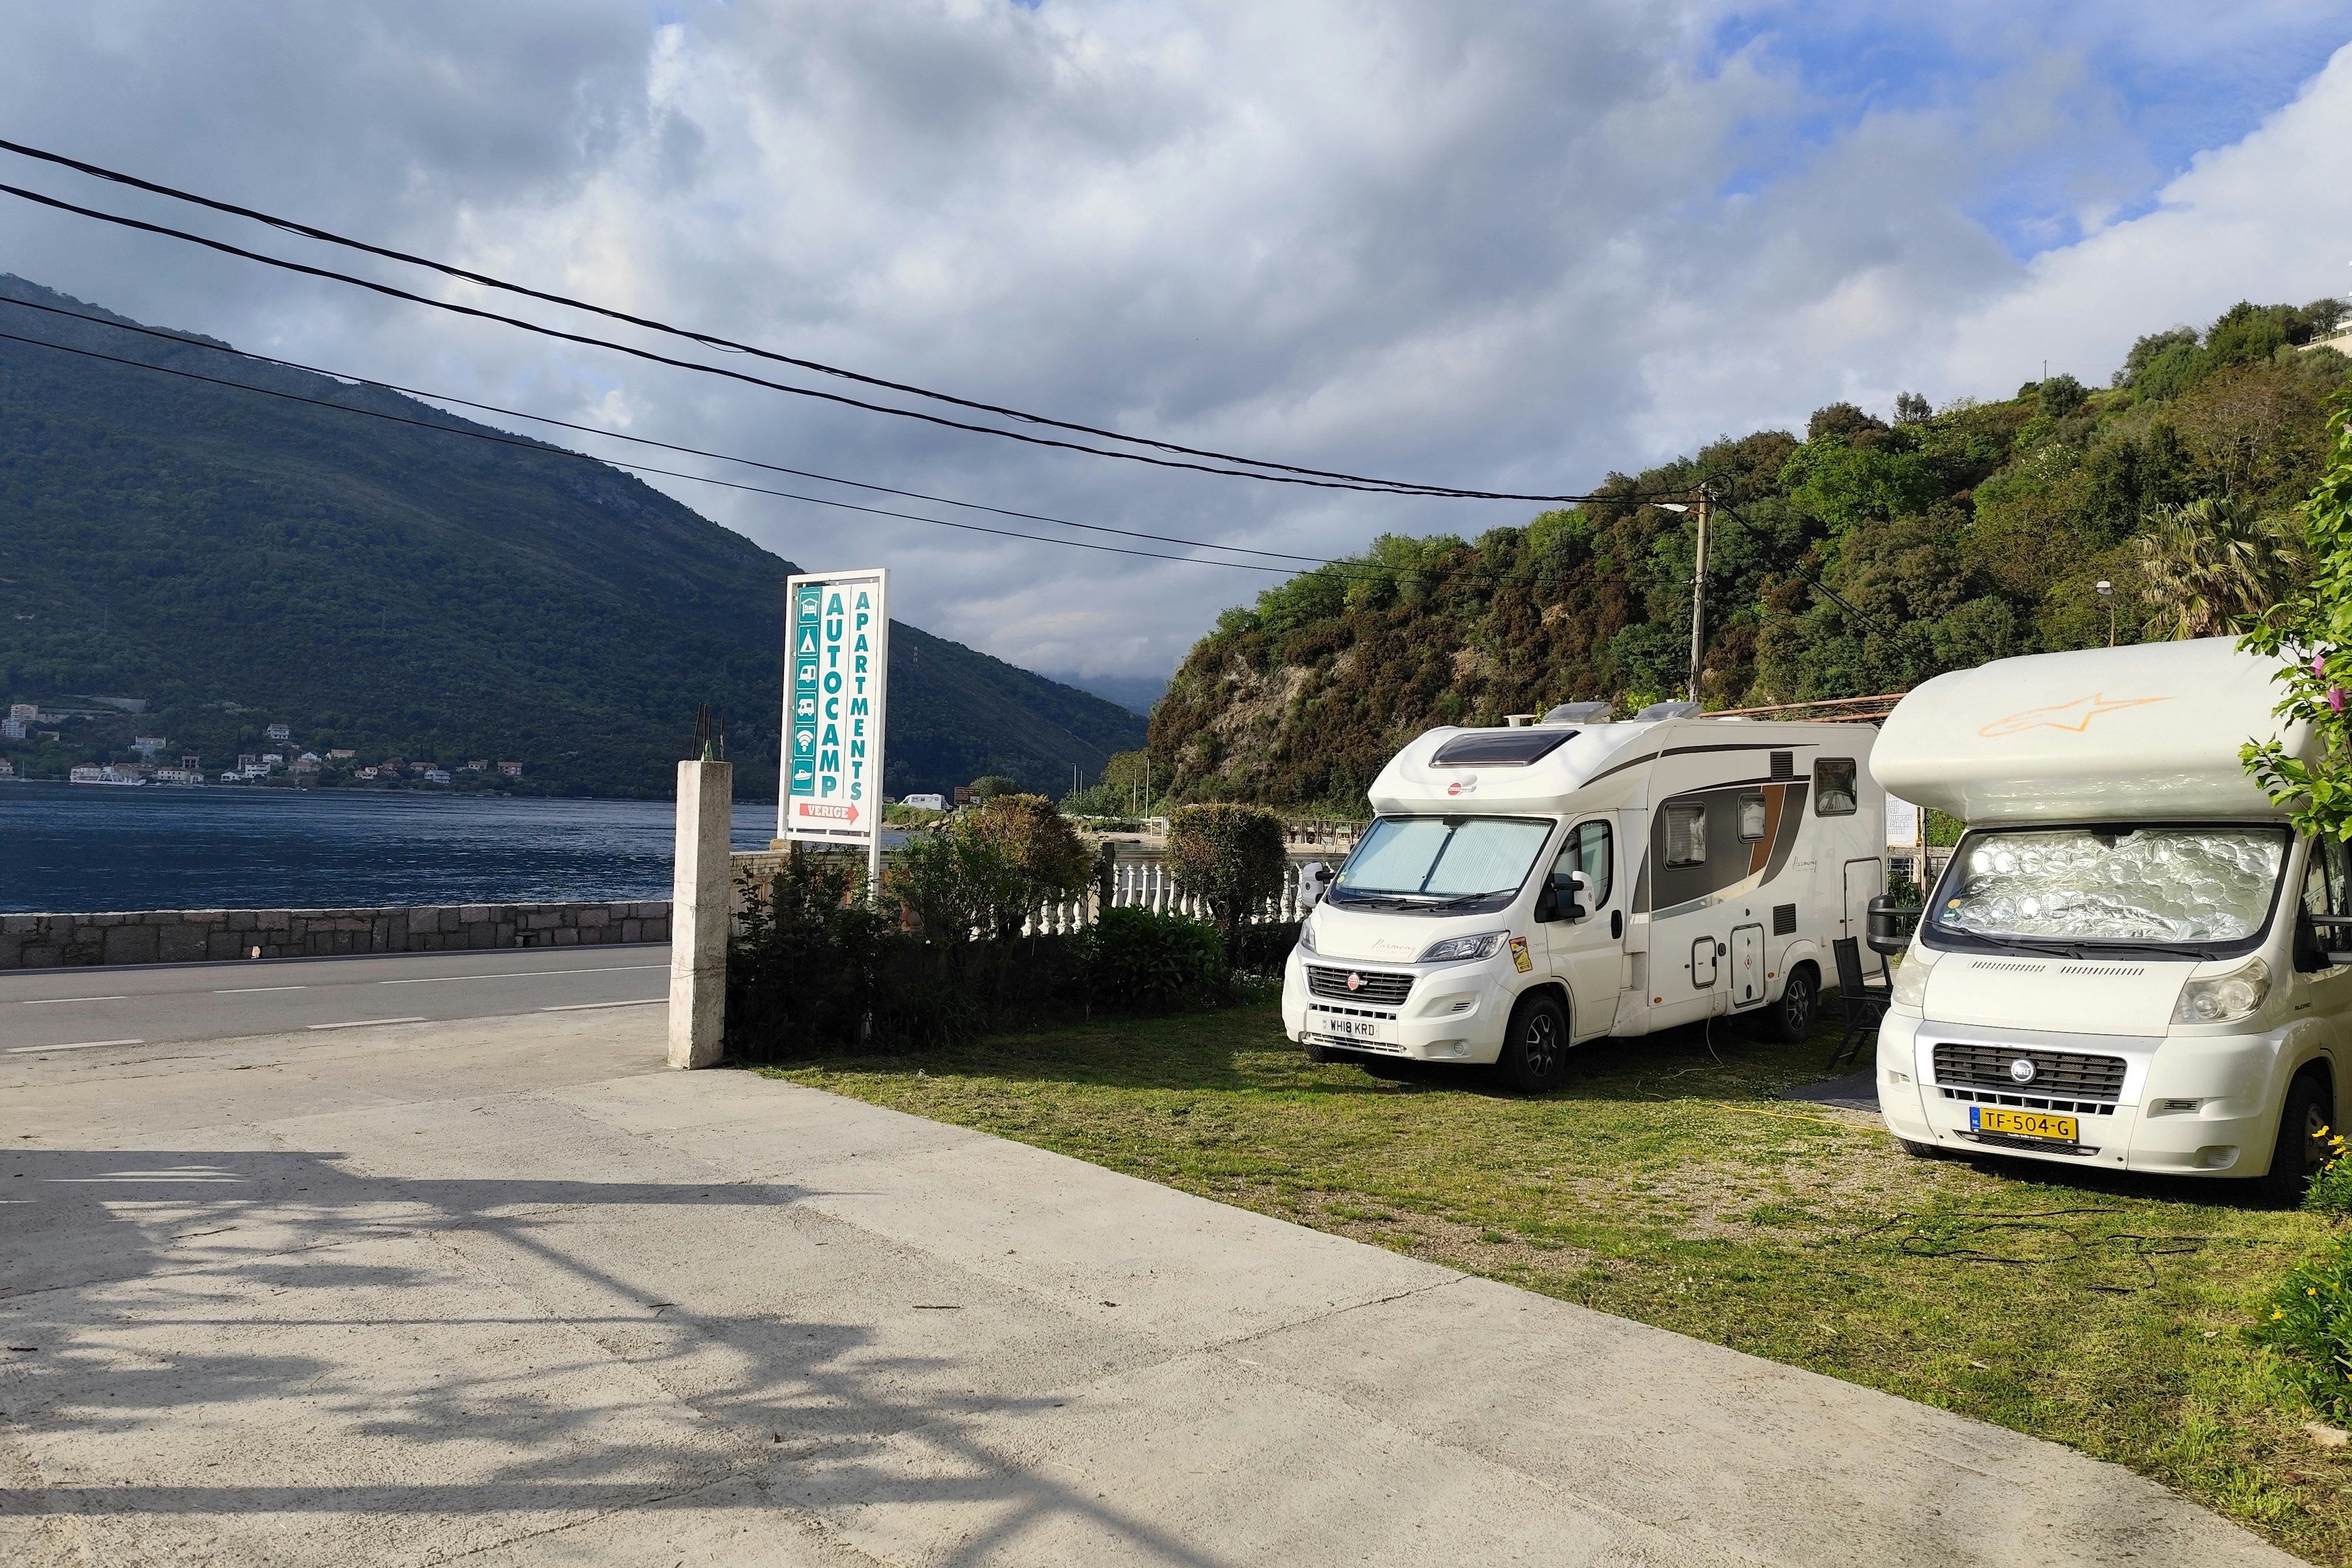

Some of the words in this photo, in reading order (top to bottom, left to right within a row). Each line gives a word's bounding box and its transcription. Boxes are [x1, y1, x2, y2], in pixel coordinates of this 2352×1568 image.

[819, 593, 845, 798] AUTOCAMP
[850, 591, 870, 801] APARTMENTS
[807, 805, 849, 819] VERIGE
[1372, 938, 1416, 958] Harmony
[1330, 1019, 1352, 1033] WH18
[1355, 1023, 1374, 1036] KRD
[2014, 1065, 2030, 1076] FIAT
[1985, 1112, 2069, 1136] TF-504-G
